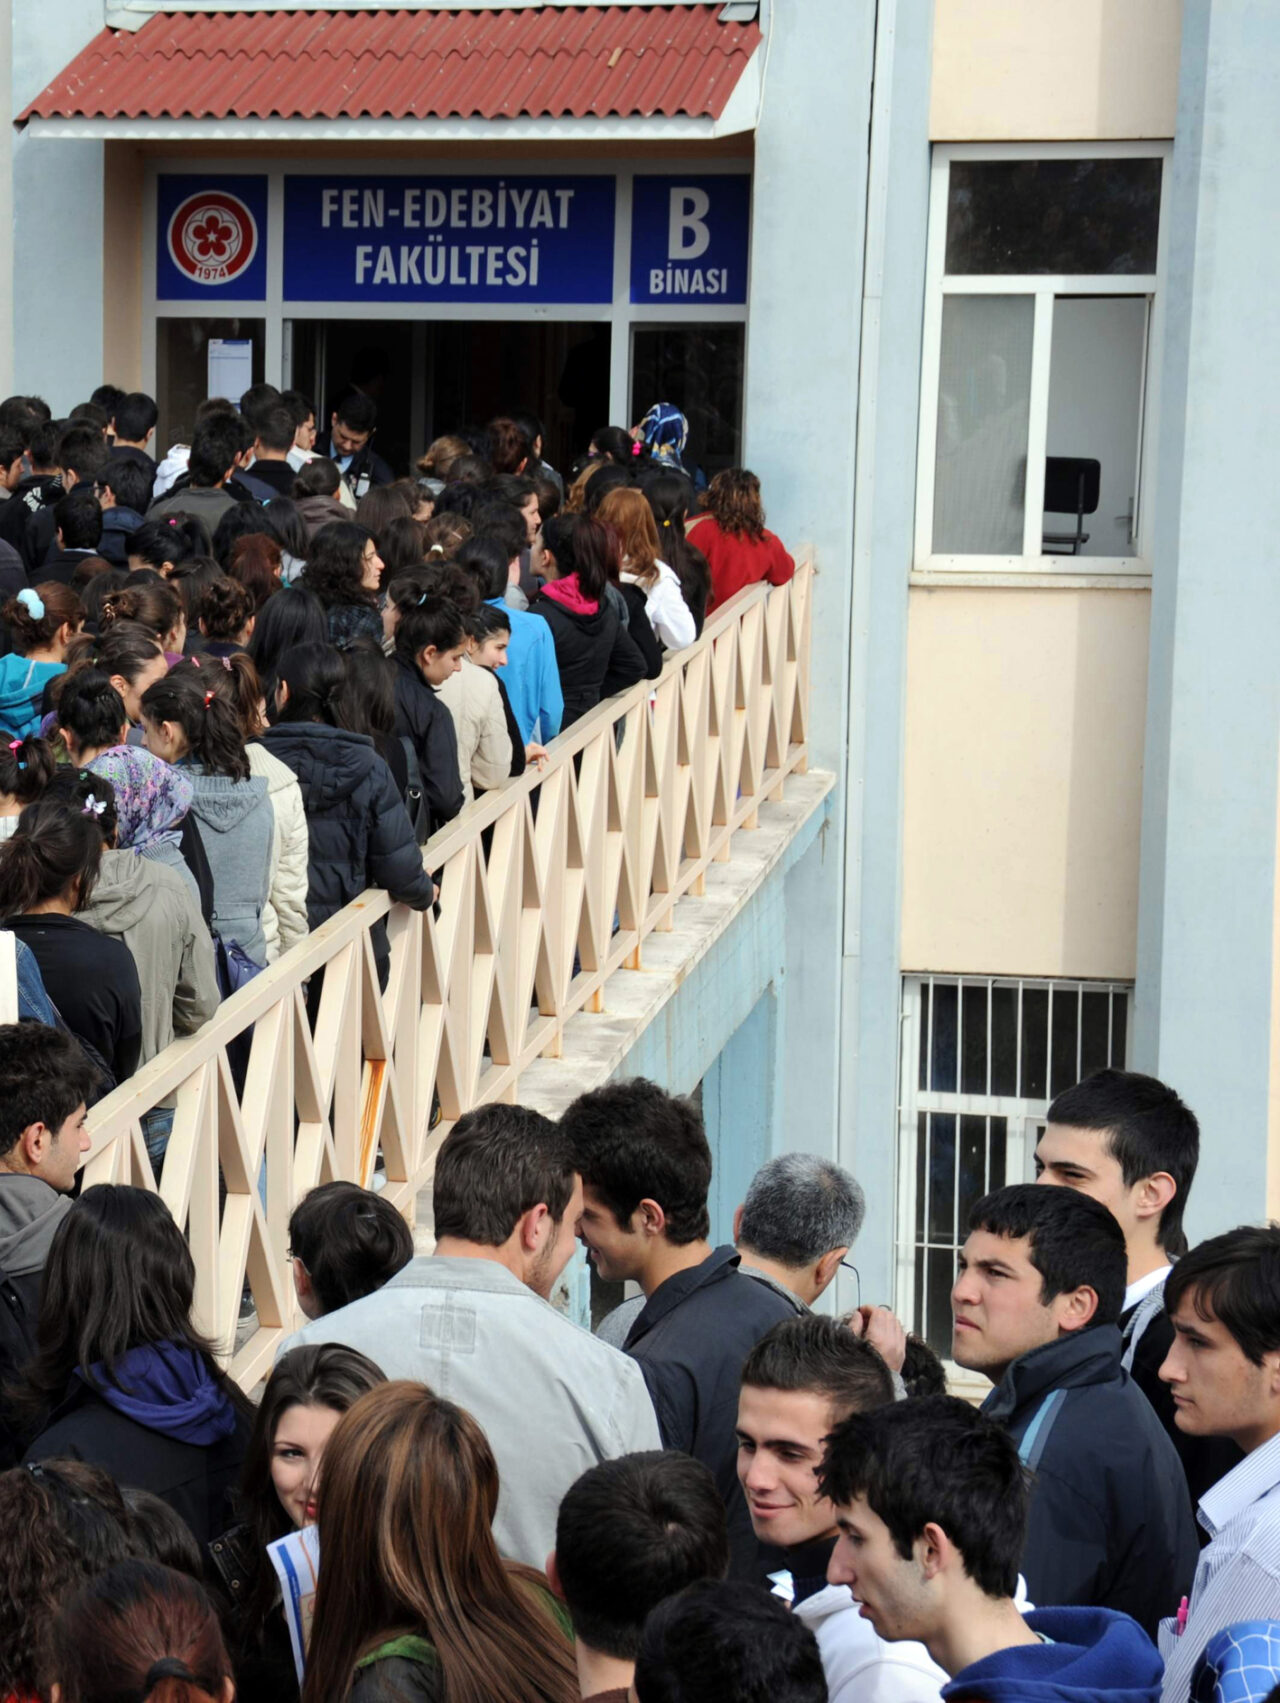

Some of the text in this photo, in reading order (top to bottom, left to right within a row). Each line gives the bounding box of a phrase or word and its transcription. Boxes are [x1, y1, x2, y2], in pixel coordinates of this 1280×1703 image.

[321, 181, 575, 228] FEN-EDEBİYAT
[668, 187, 710, 260] B
[197, 266, 227, 280] 1974
[355, 235, 539, 286] FAKÜLTESİ
[649, 262, 728, 294] BİNASI
